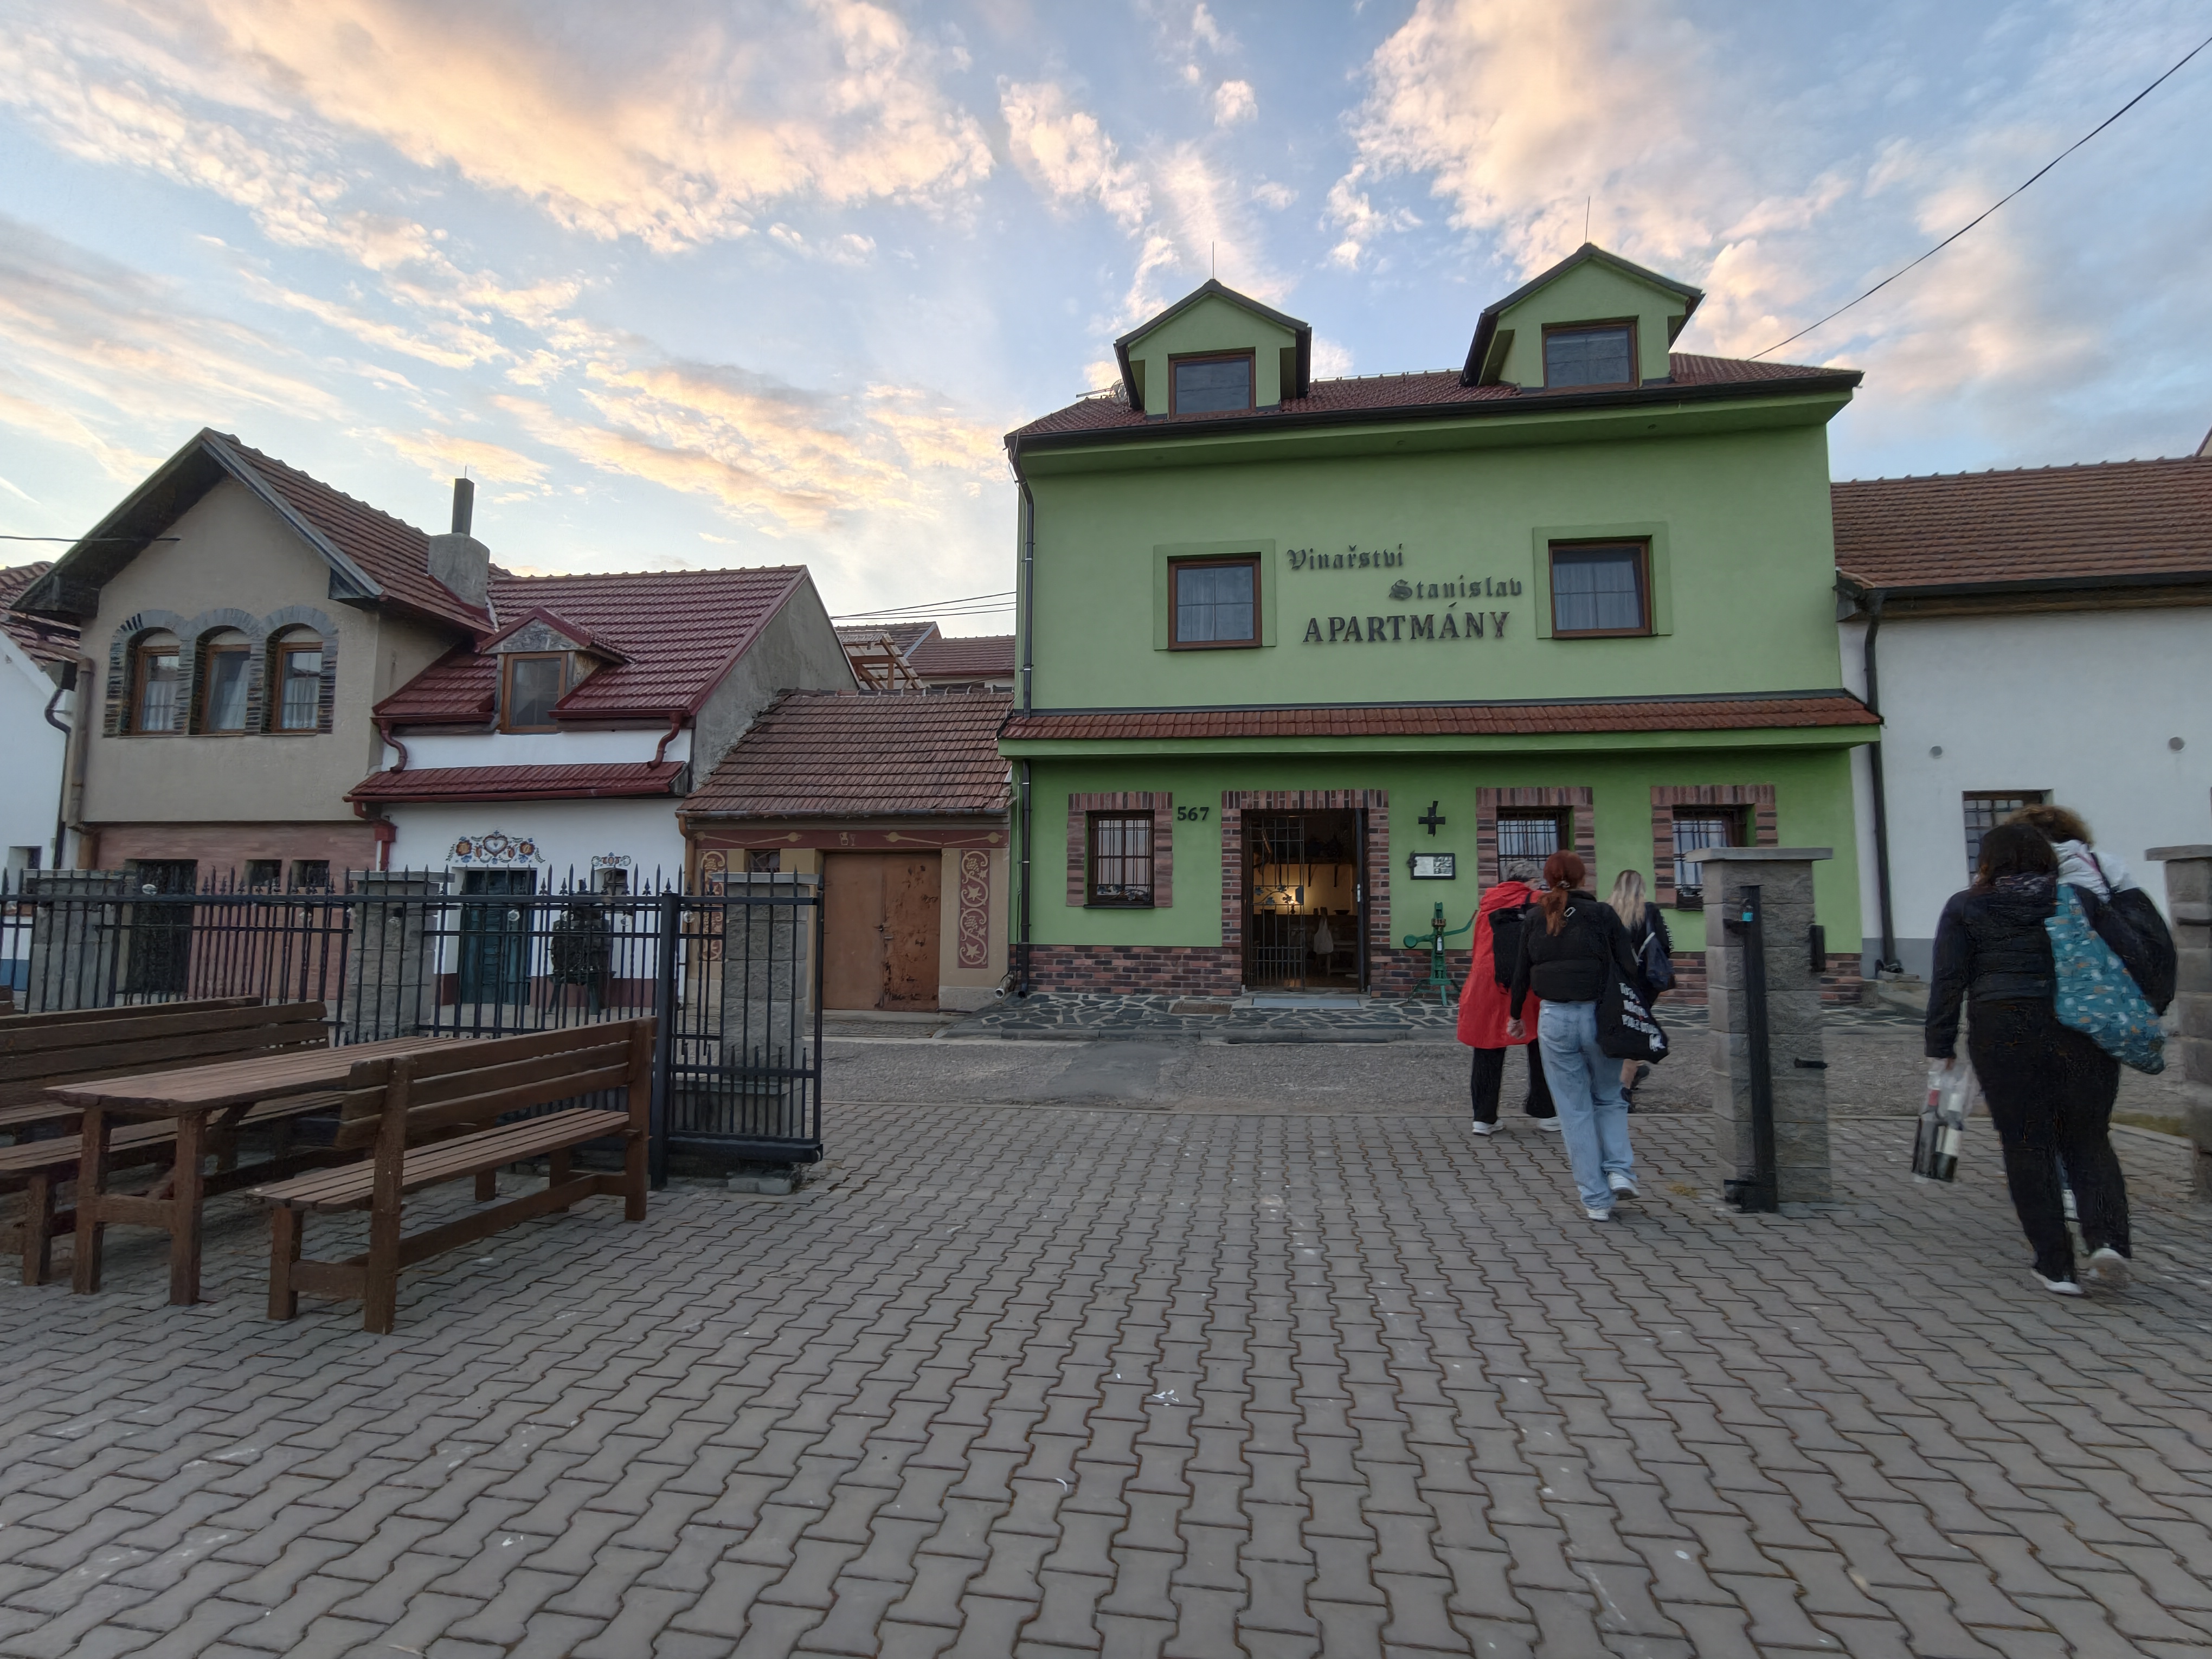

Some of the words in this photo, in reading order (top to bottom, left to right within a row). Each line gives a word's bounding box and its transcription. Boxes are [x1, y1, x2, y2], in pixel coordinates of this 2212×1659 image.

[1287, 543, 1403, 570] Vinařství
[1389, 575, 1522, 600] Stanislav
[1303, 602, 1510, 642] APARTMÁNY
[1177, 806, 1209, 821] 567
